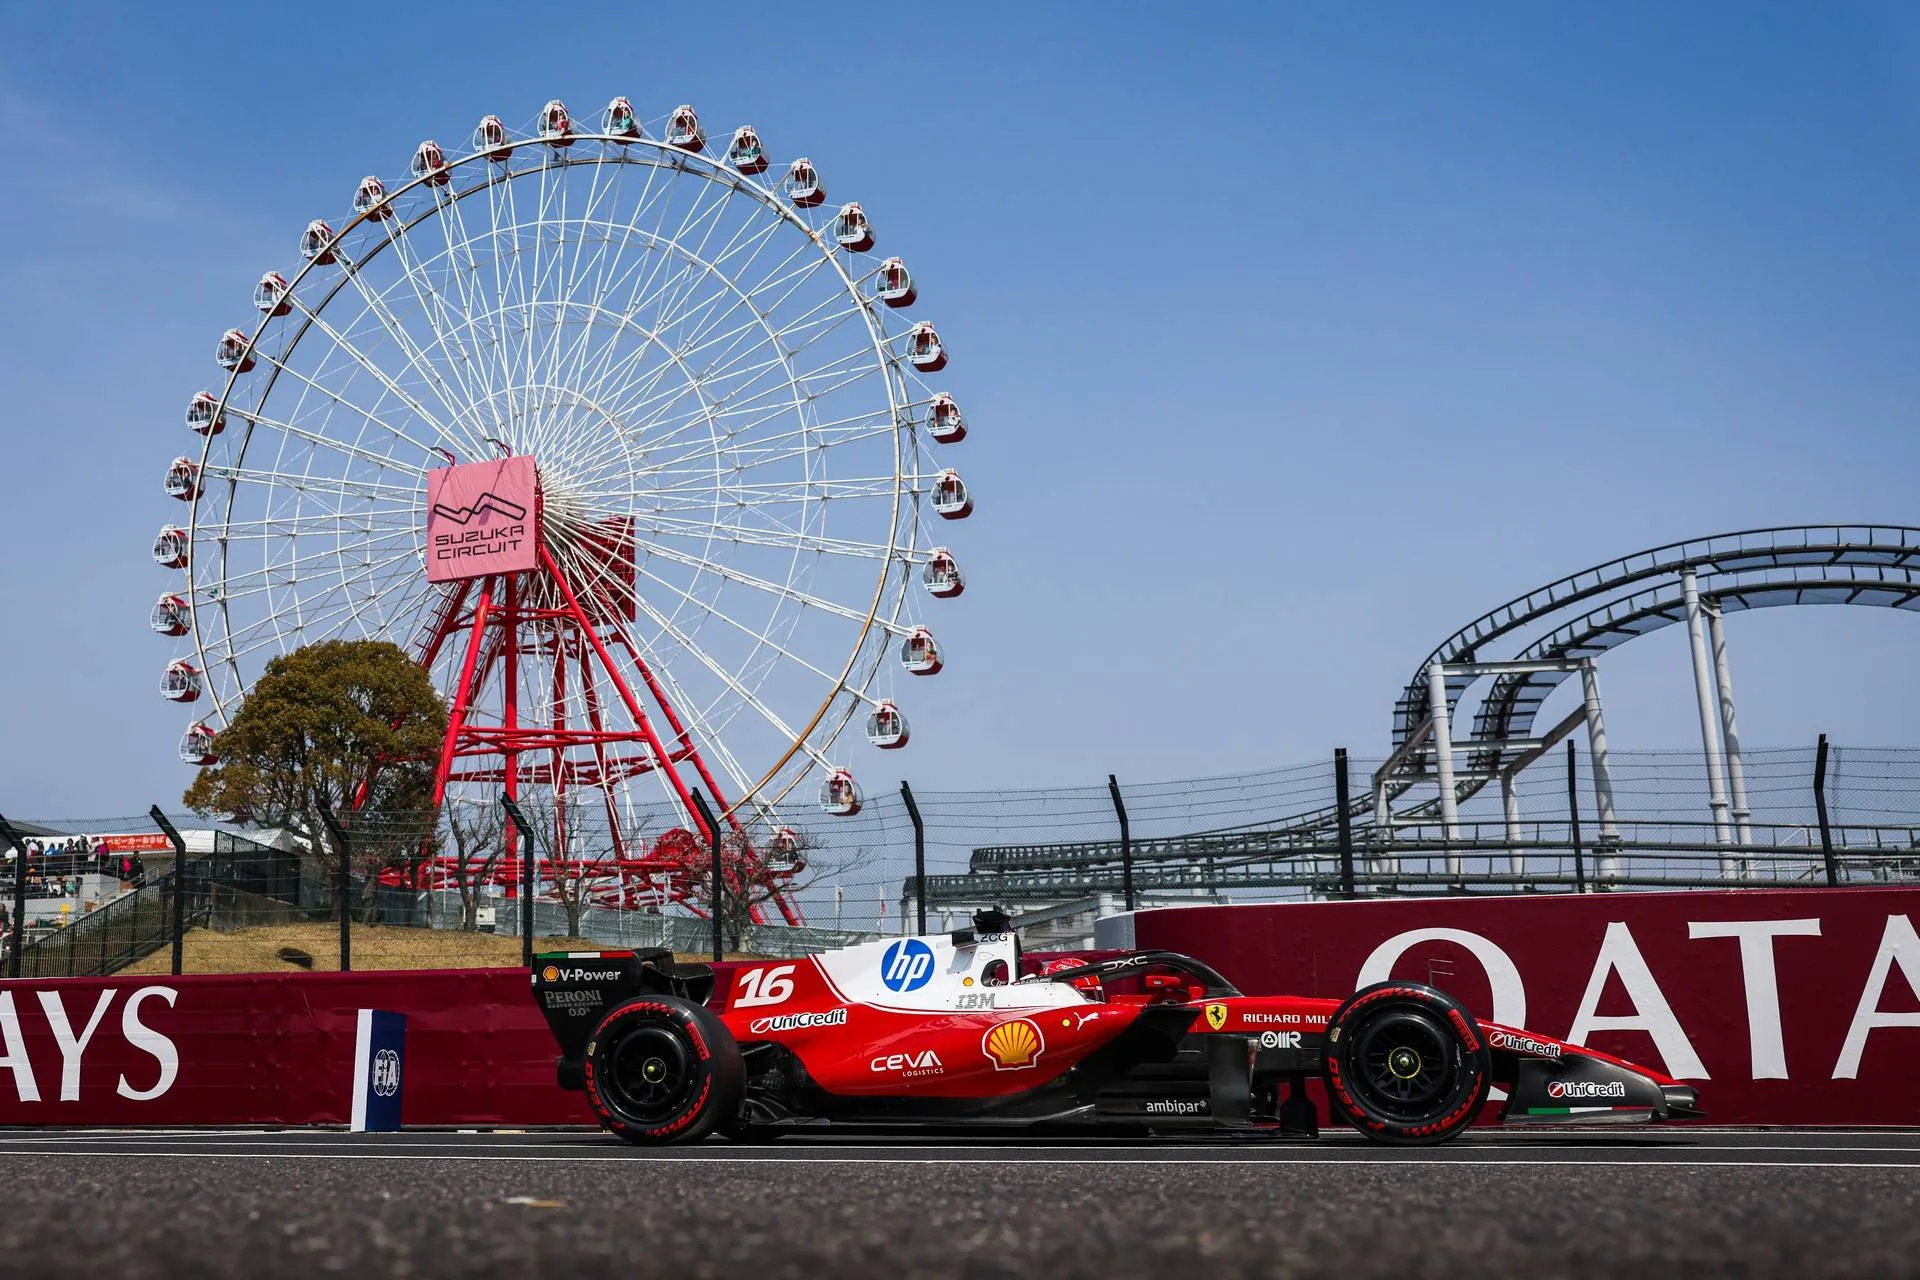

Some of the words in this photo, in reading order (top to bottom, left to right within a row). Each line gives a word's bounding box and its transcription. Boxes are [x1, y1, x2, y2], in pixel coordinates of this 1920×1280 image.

[435, 525, 525, 546] SUZUKA
[437, 540, 522, 560] CIRCUIT
[885, 939, 932, 992] hp
[1101, 955, 1148, 971] DXC
[559, 968, 621, 982] V-Power
[733, 965, 795, 1008] 16
[544, 989, 603, 1004] PERONI
[955, 993, 996, 1010] IBM
[771, 1009, 846, 1030] UniCredit
[1243, 1013, 1301, 1024] RICHARD
[1305, 1014, 1333, 1025] MIL
[1505, 1035, 1561, 1057] UniCredit
[374, 1059, 398, 1087] FIA
[902, 1067, 944, 1077] LOGISTICS
[1564, 1081, 1625, 1097] UniCredit
